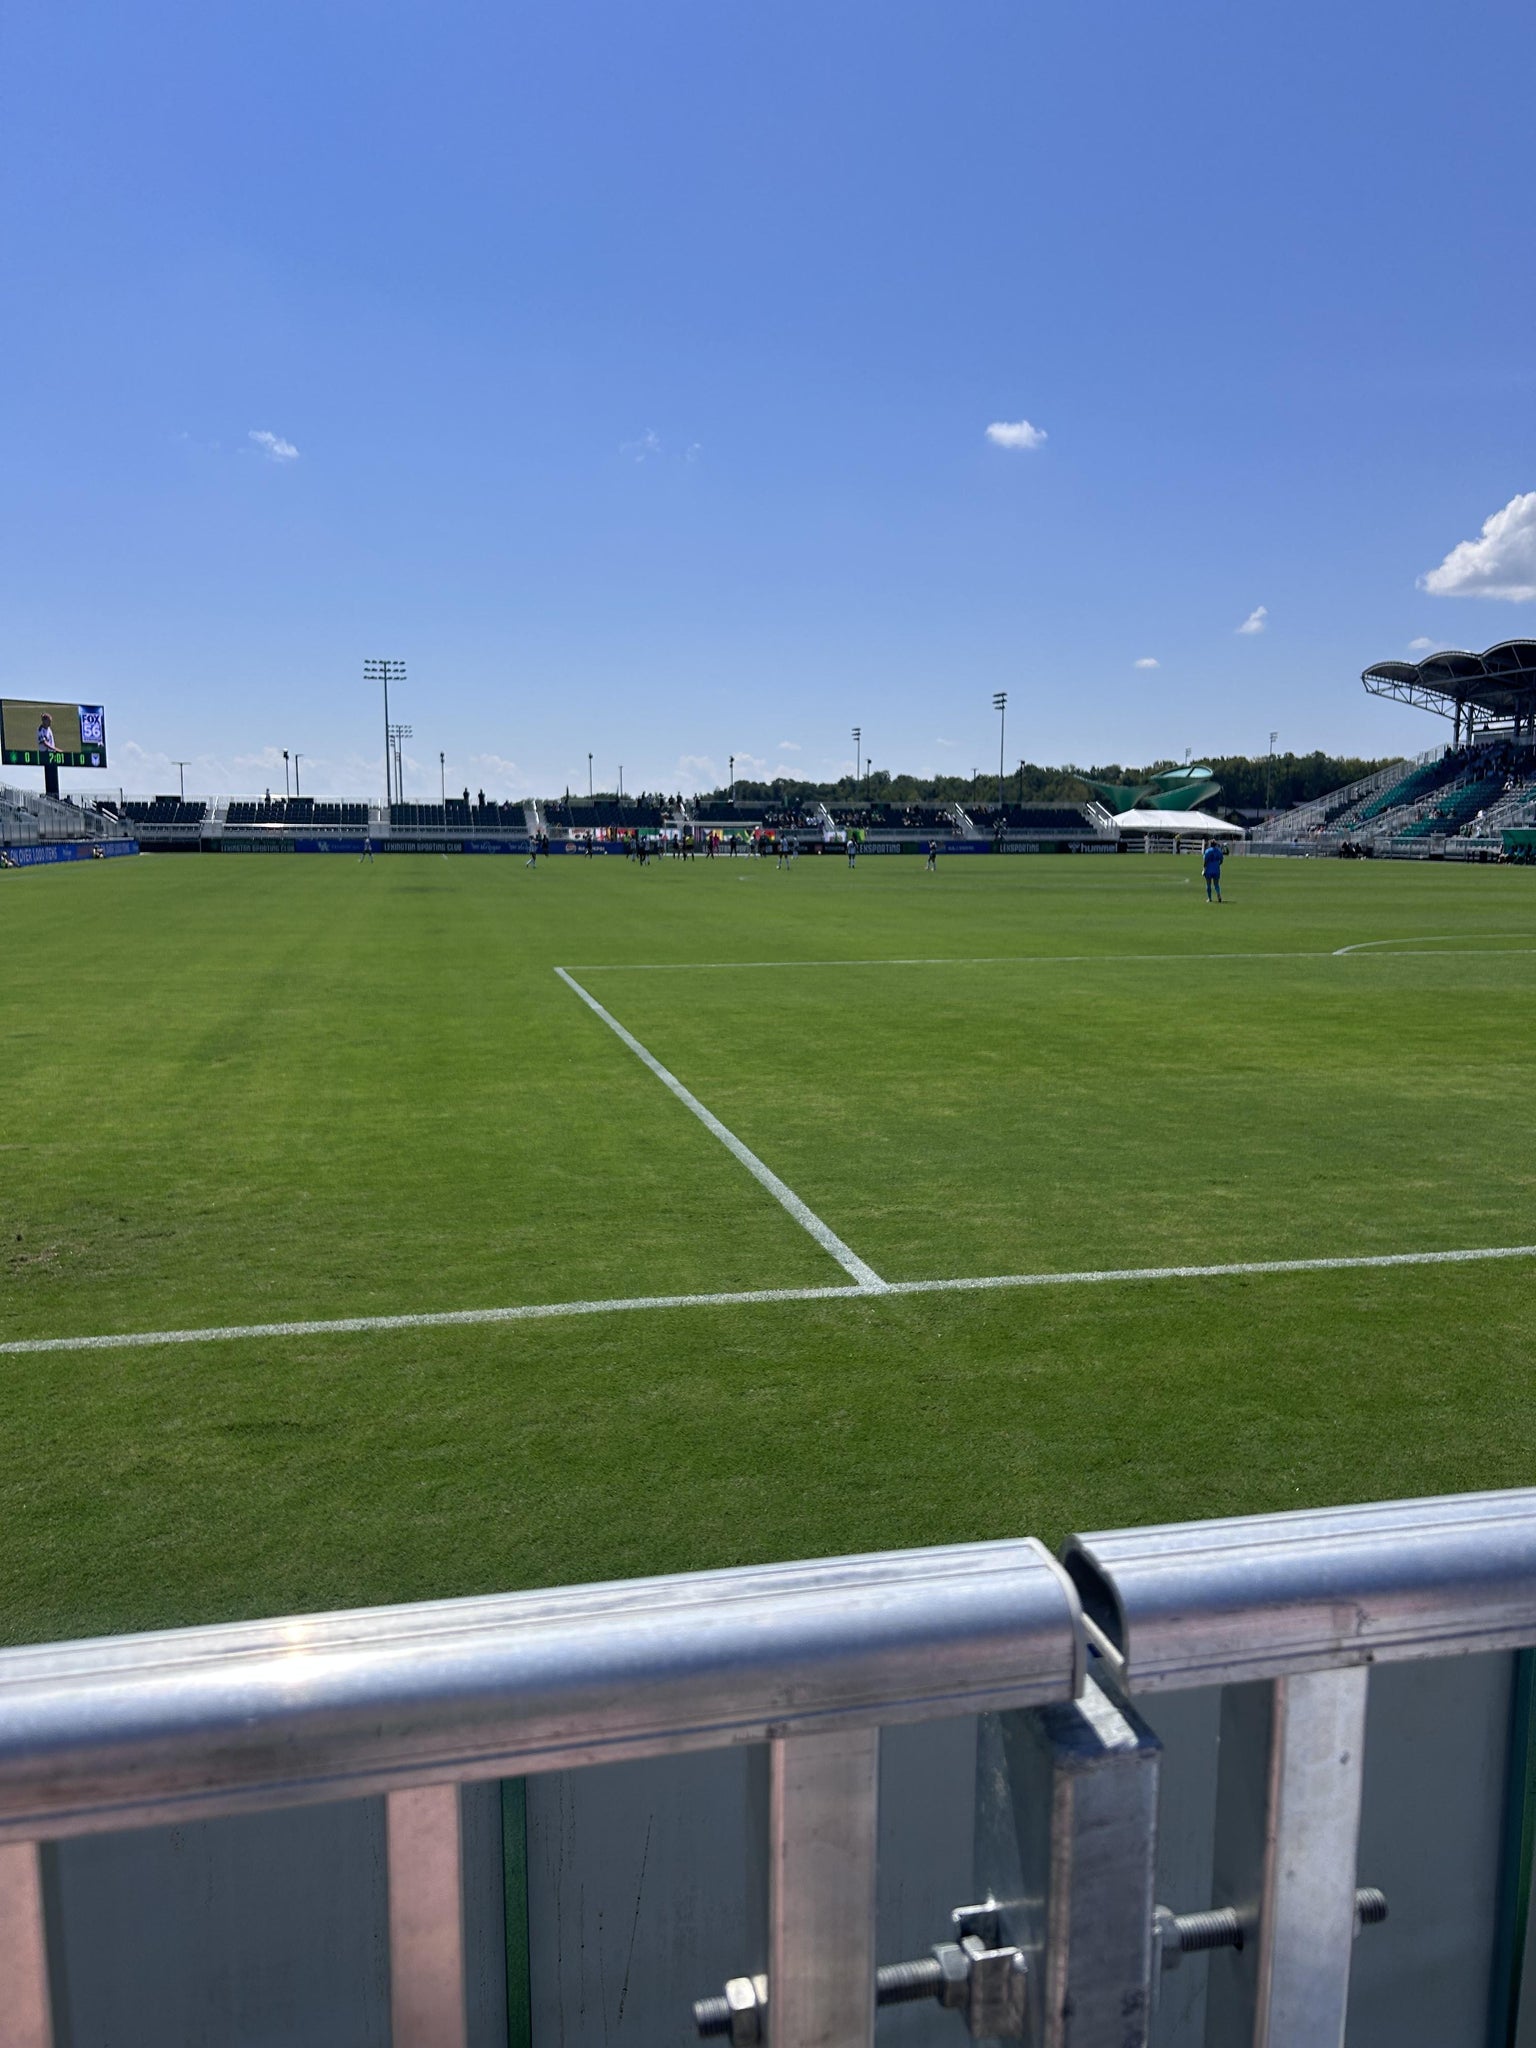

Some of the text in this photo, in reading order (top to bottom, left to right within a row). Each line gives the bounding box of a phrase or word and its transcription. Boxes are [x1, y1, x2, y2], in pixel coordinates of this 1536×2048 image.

[82, 714, 100, 723] FOX
[84, 725, 101, 737] 56
[24, 752, 30, 763] 0
[49, 753, 64, 764] 7:01
[79, 754, 85, 765] 0
[384, 843, 415, 852] LEXINGTON
[417, 843, 445, 852] SPORTING
[447, 843, 462, 852] CLUB
[856, 844, 901, 853] EXSPORTING
[1081, 842, 1118, 853] hummel
[19, 848, 32, 864] OVER
